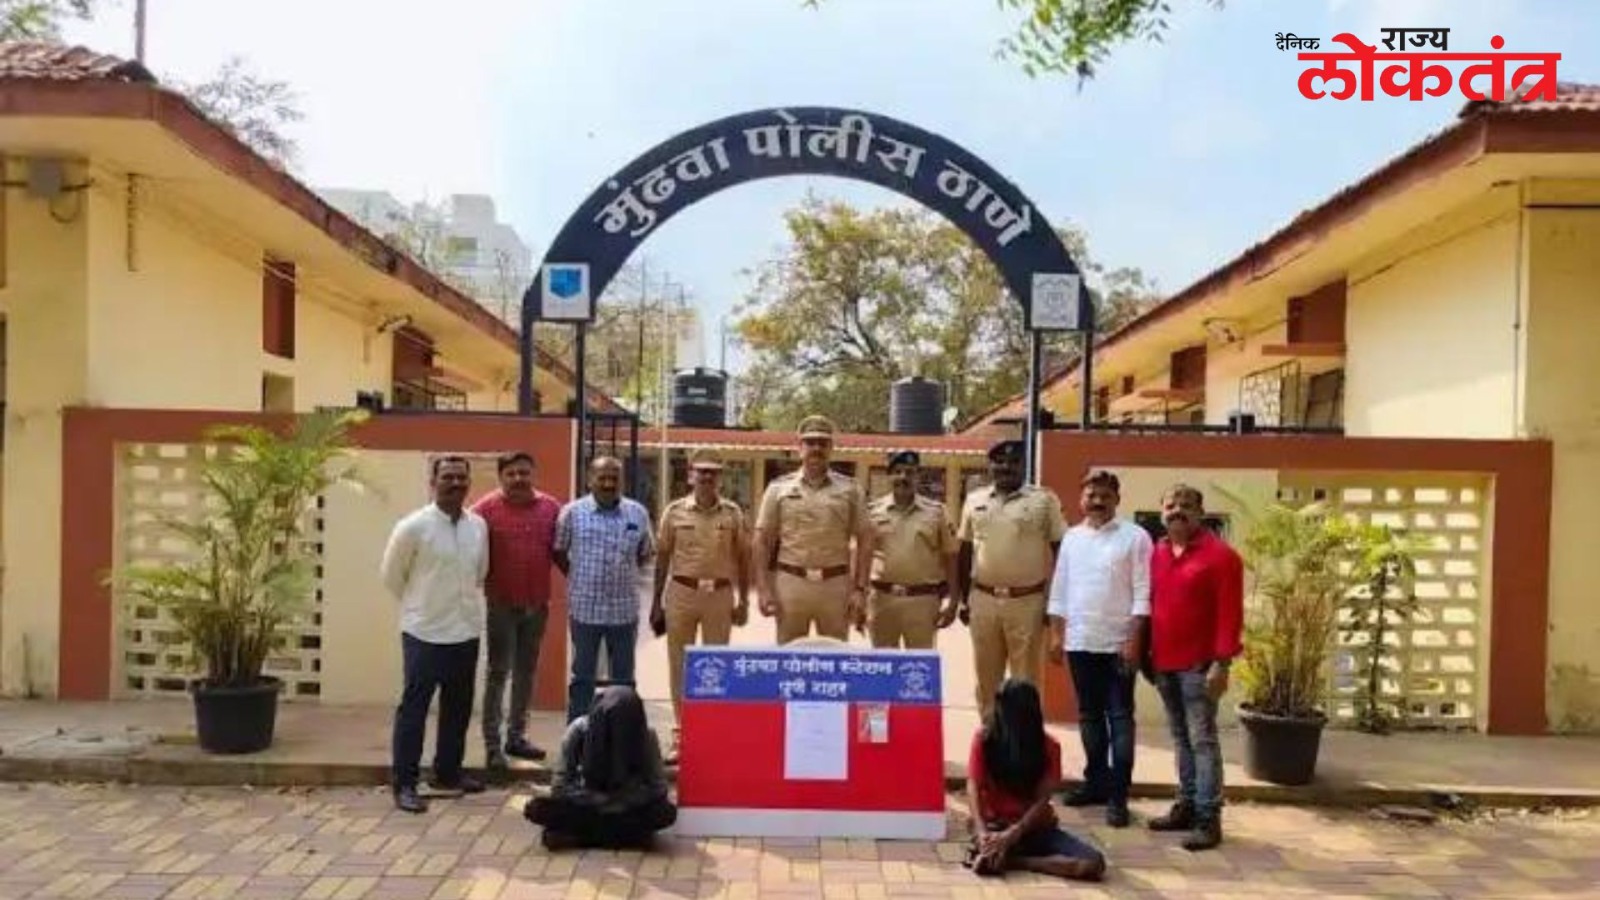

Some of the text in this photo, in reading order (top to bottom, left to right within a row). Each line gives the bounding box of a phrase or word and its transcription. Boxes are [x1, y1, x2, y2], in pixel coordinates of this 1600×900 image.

[594, 108, 1032, 247] मुंढवा पोलीस ठाणे
